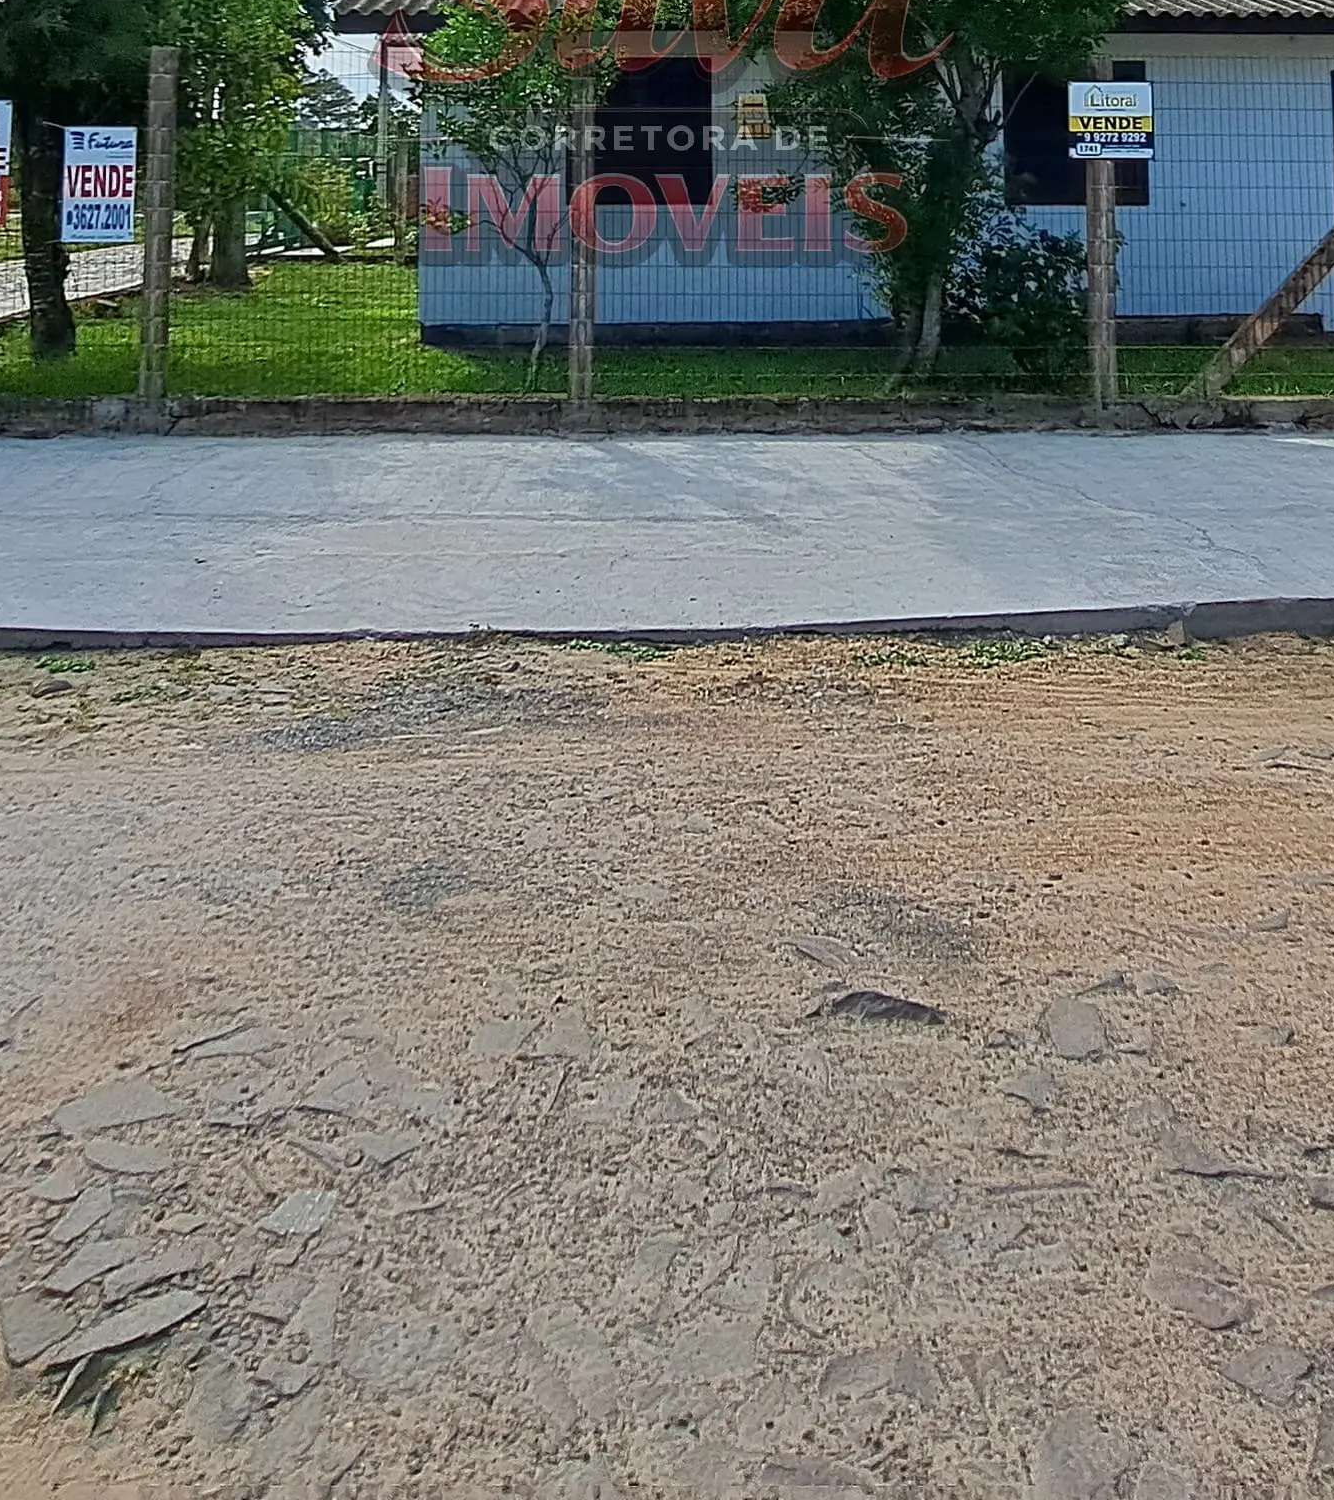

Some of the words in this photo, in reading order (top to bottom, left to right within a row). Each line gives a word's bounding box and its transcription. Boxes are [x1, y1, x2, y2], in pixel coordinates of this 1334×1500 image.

[1090, 94, 1137, 107] Litoral
[1079, 117, 1142, 129] VENDE
[67, 165, 134, 197] VENDE
[73, 203, 131, 230] 3627.2001
